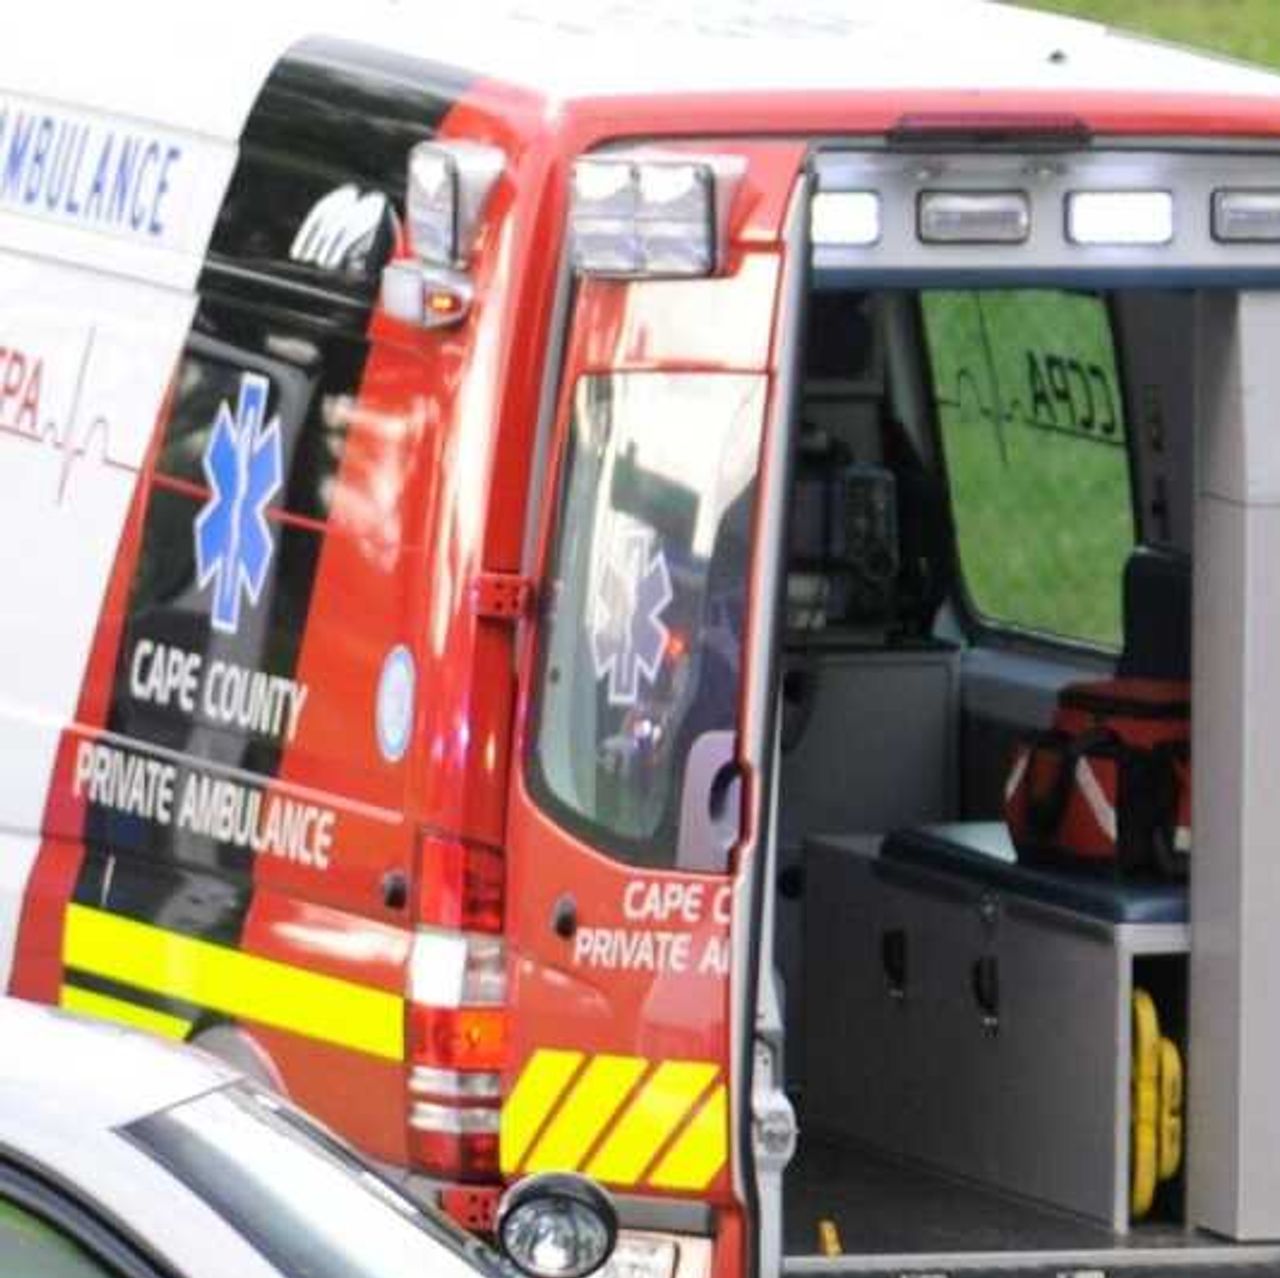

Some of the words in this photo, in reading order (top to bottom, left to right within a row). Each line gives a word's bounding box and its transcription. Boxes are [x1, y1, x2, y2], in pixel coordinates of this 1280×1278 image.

[0, 104, 182, 235] MBULANCE
[130, 639, 202, 712] CAPE
[203, 660, 308, 744] COUNTY
[72, 739, 176, 824] PRIVATE
[177, 773, 336, 870] AMBULANCE
[574, 927, 693, 972] PRIVATE
[623, 880, 704, 923] CAPE
